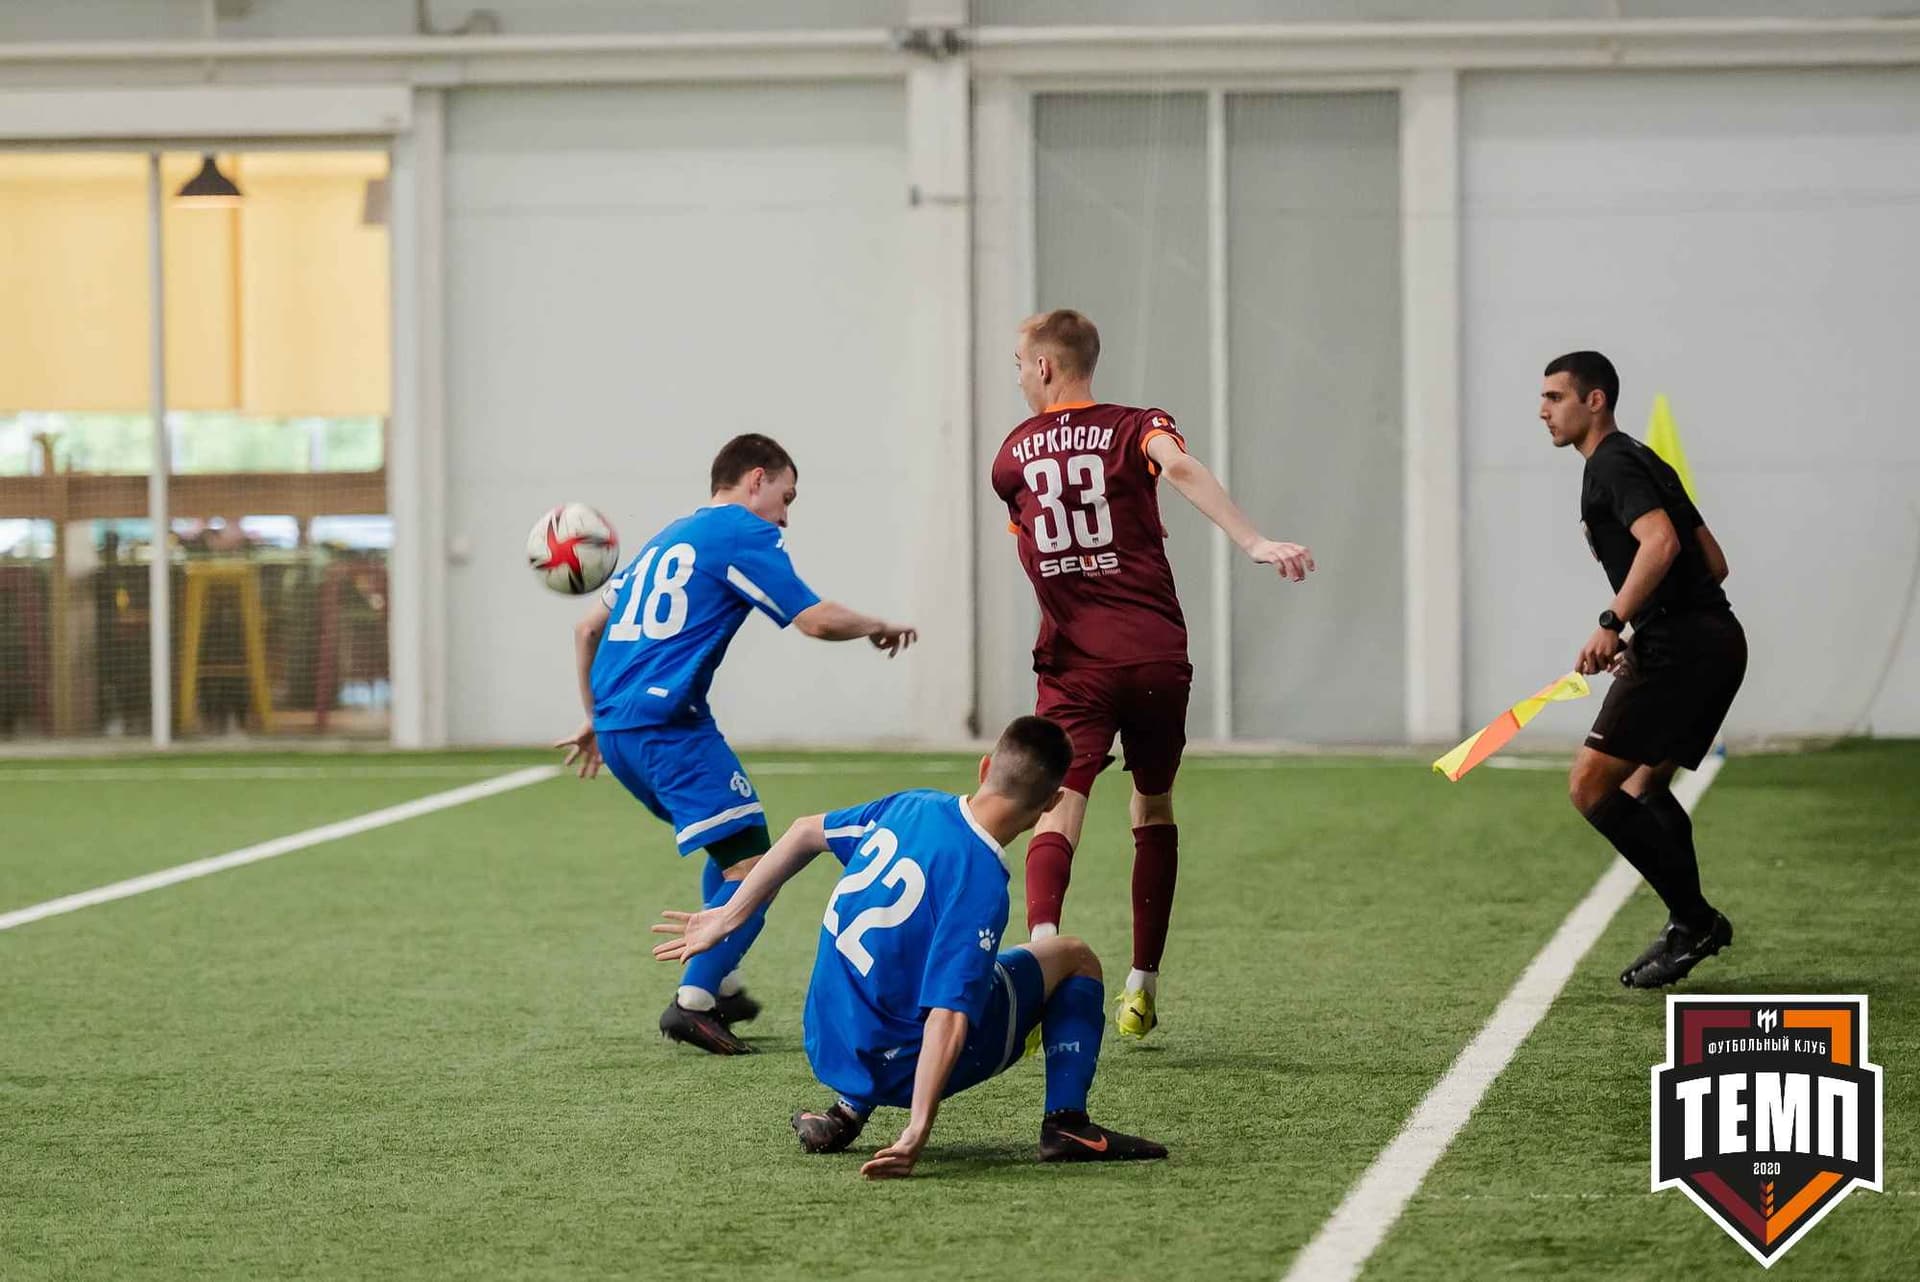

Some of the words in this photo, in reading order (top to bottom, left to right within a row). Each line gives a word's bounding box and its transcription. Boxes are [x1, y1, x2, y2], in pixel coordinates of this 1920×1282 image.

[1012, 425, 1113, 463] ЧЕРКАСОВ
[1023, 454, 1113, 553] 33
[608, 542, 697, 641] 18
[1039, 552, 1119, 577] SEUS
[823, 827, 926, 978] 22
